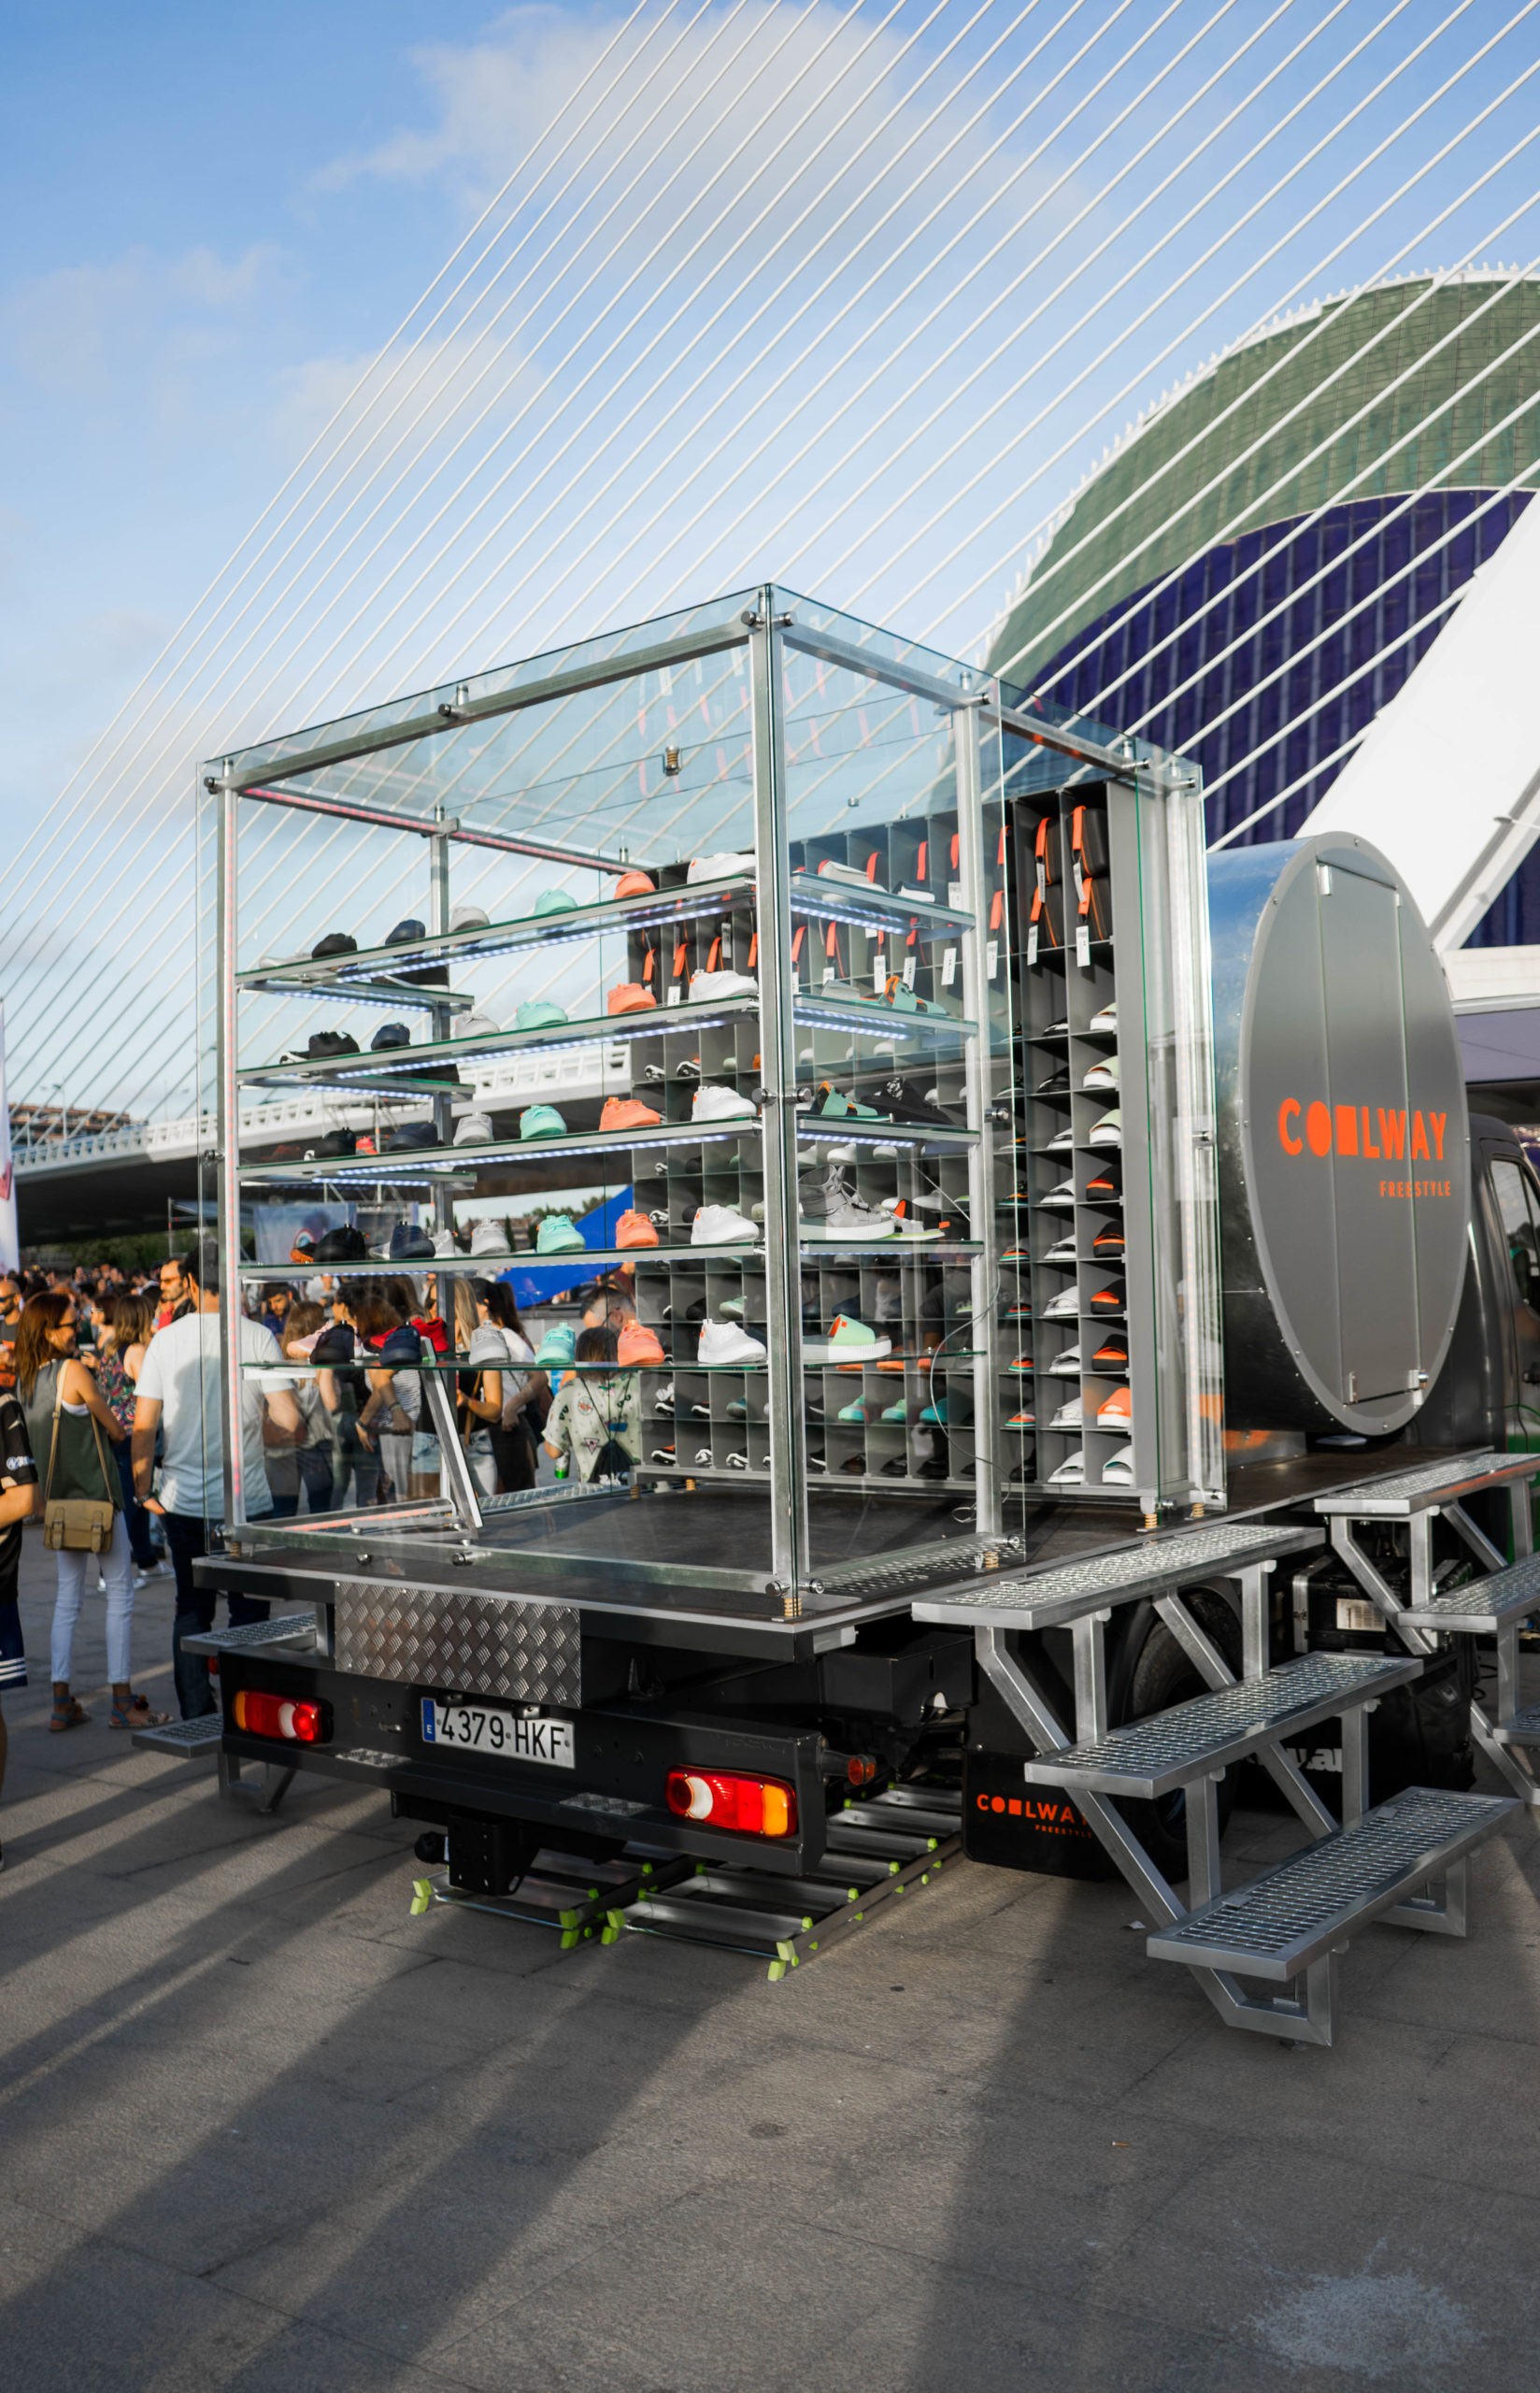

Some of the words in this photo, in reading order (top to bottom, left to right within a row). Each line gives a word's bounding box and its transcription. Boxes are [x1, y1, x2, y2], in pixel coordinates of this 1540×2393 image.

[1379, 1181, 1451, 1197] FREESTYLE
[441, 1707, 504, 1749] 4379
[515, 1719, 564, 1759] HKF
